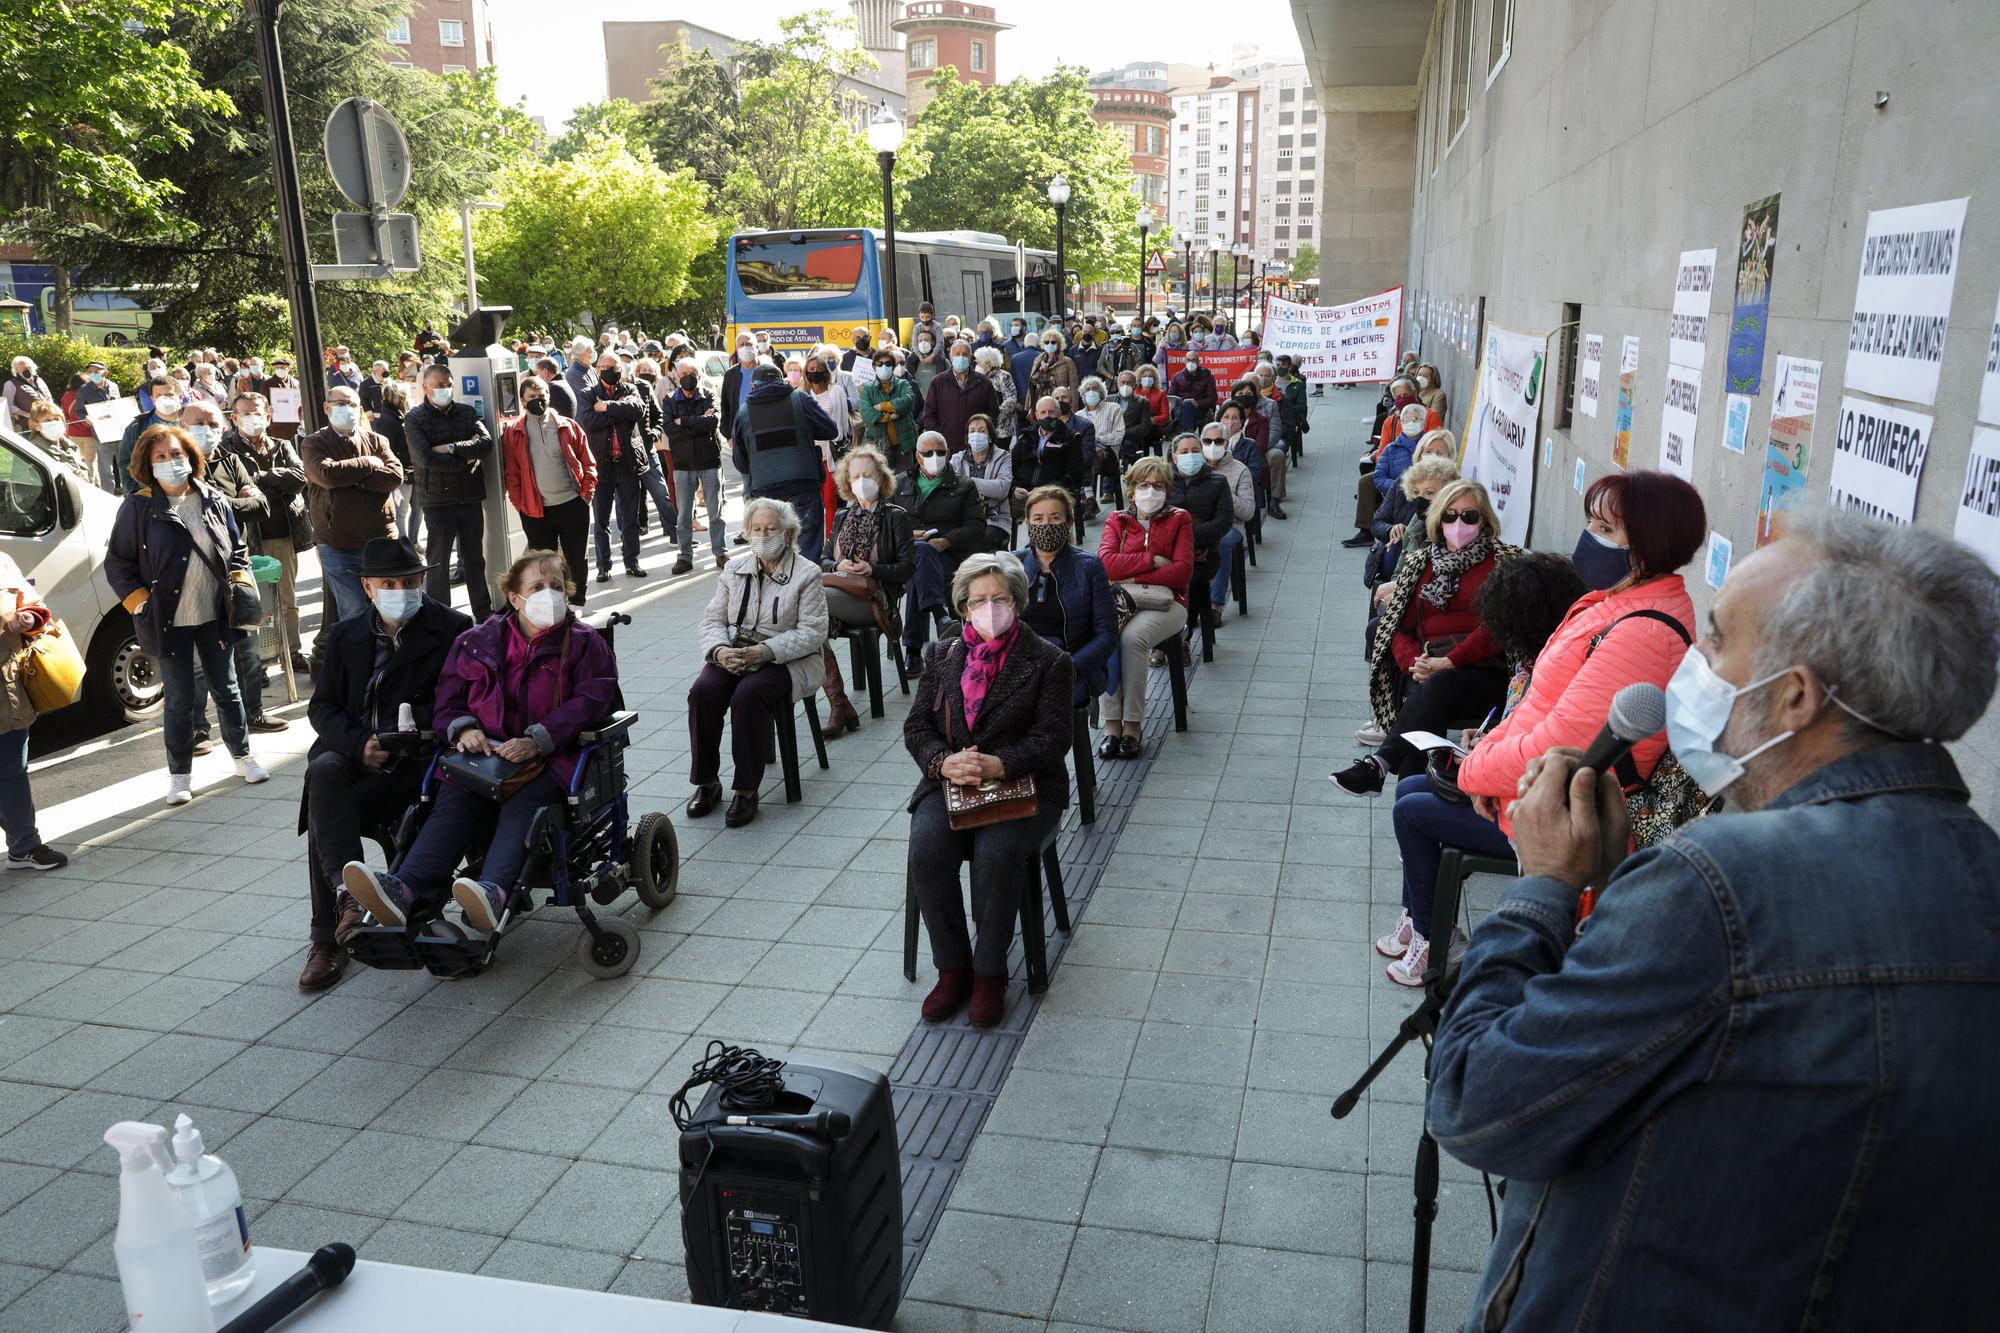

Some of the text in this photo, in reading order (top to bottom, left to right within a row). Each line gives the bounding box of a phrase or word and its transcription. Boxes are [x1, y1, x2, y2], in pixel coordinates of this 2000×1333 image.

[1873, 232, 1914, 275] RECURSOS
[1909, 228, 1954, 275] HUMANOS
[1352, 300, 1391, 316] CONTRA
[1321, 326, 1331, 335] DE
[1340, 319, 1372, 333] ESPERA
[793, 335, 821, 343] ASTURIAS
[1880, 314, 1896, 355] DE
[1891, 315, 1911, 357] LAS
[1280, 341, 1321, 349] COPAGOS
[1325, 340, 1336, 349] DE
[1331, 354, 1337, 363] A
[1344, 353, 1356, 361] LA
[466, 380, 476, 391] P
[1216, 379, 1228, 387] LOS
[1836, 408, 1924, 478] LO PRIMERO:
[1791, 442, 1802, 469] 3
